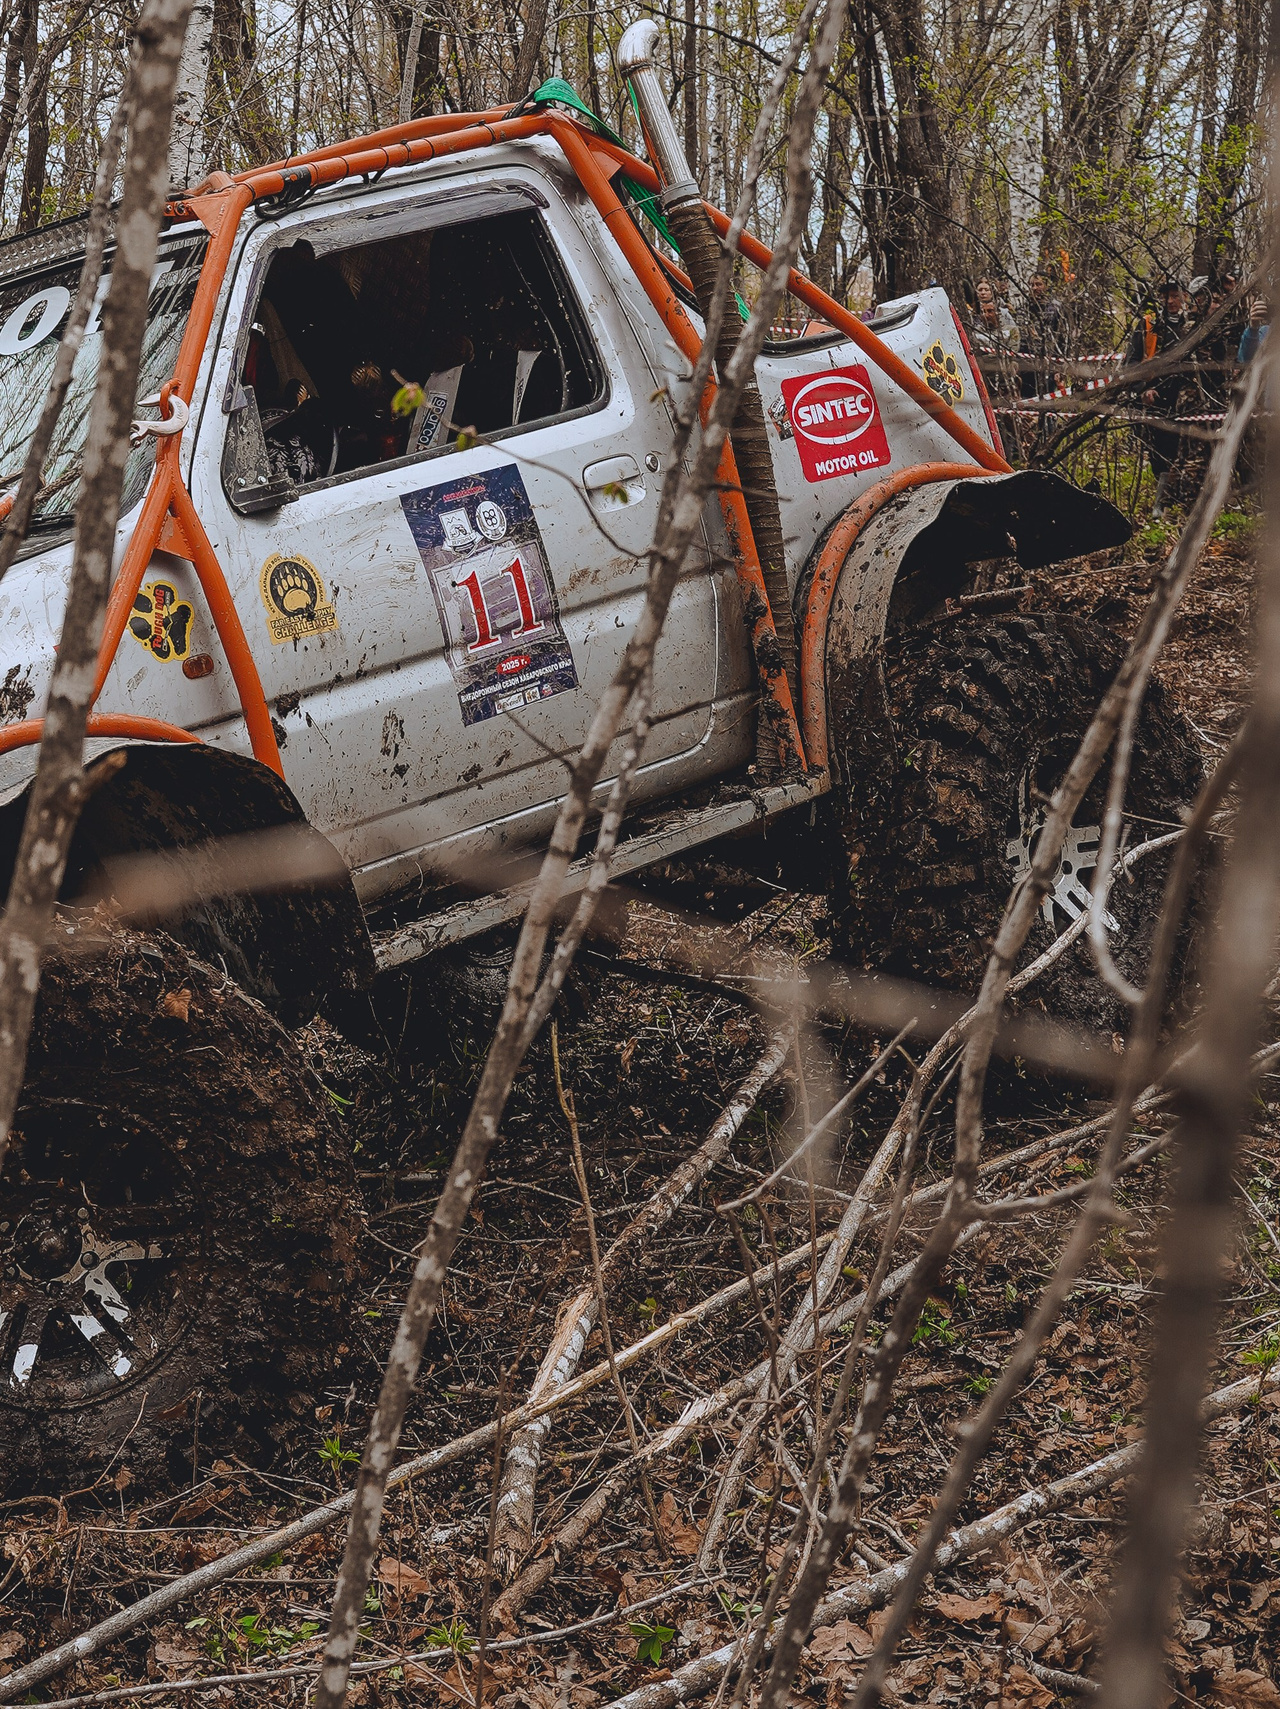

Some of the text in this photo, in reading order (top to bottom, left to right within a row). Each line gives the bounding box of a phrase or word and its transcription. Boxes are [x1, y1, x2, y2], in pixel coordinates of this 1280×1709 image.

[419, 398, 447, 444] sparco
[797, 394, 870, 428] SINTEC
[814, 450, 879, 476] MOTOR OIL
[155, 588, 165, 611] DOG
[455, 556, 545, 651] 11
[270, 617, 285, 629] FAR
[286, 614, 303, 625] EAST
[274, 616, 335, 639] CHALLENGE
[501, 659, 520, 672] 2025
[502, 675, 519, 690] СЕЗОН
[519, 663, 559, 683] ХАБАРОВСКОГО
[558, 658, 572, 671] КРАЯ
